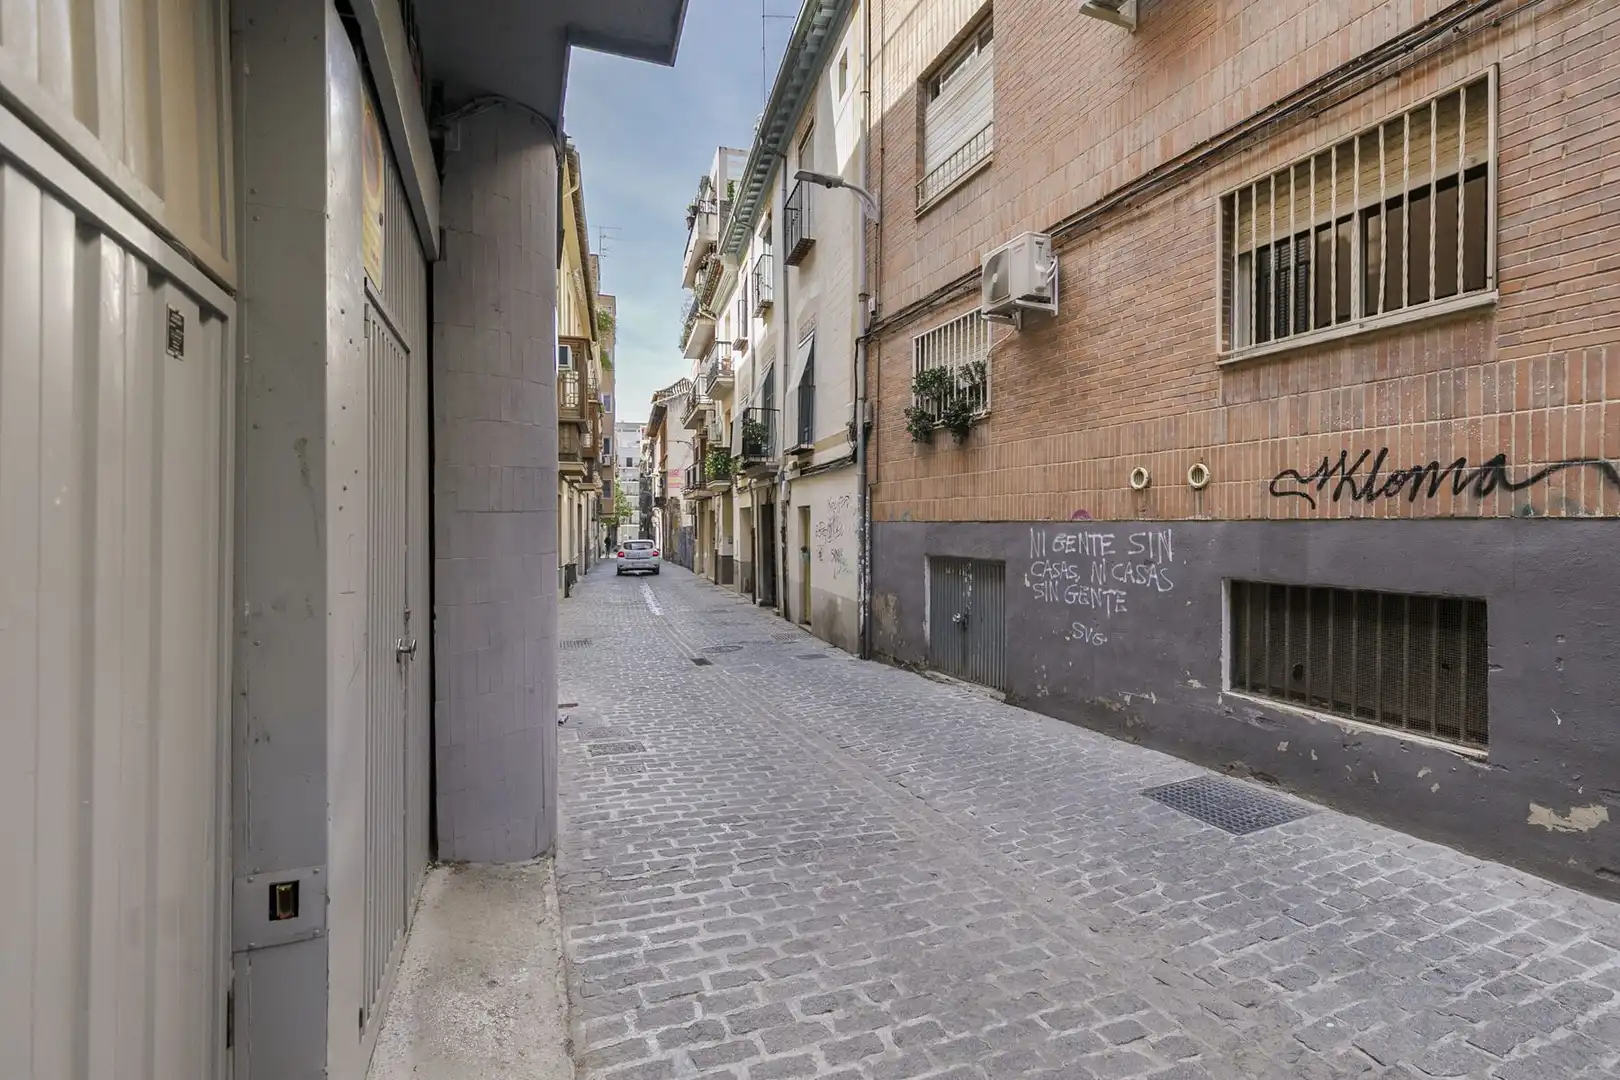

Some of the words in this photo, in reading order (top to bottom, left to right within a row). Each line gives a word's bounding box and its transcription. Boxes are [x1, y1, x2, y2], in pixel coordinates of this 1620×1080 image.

[1030, 528, 1046, 558] NI
[1052, 532, 1116, 557] GENTE
[1128, 529, 1173, 564] SIN
[1091, 558, 1106, 585] NI
[1112, 562, 1174, 592] CASAS
[1033, 580, 1059, 602] SIN
[1064, 584, 1128, 618] GENTE
